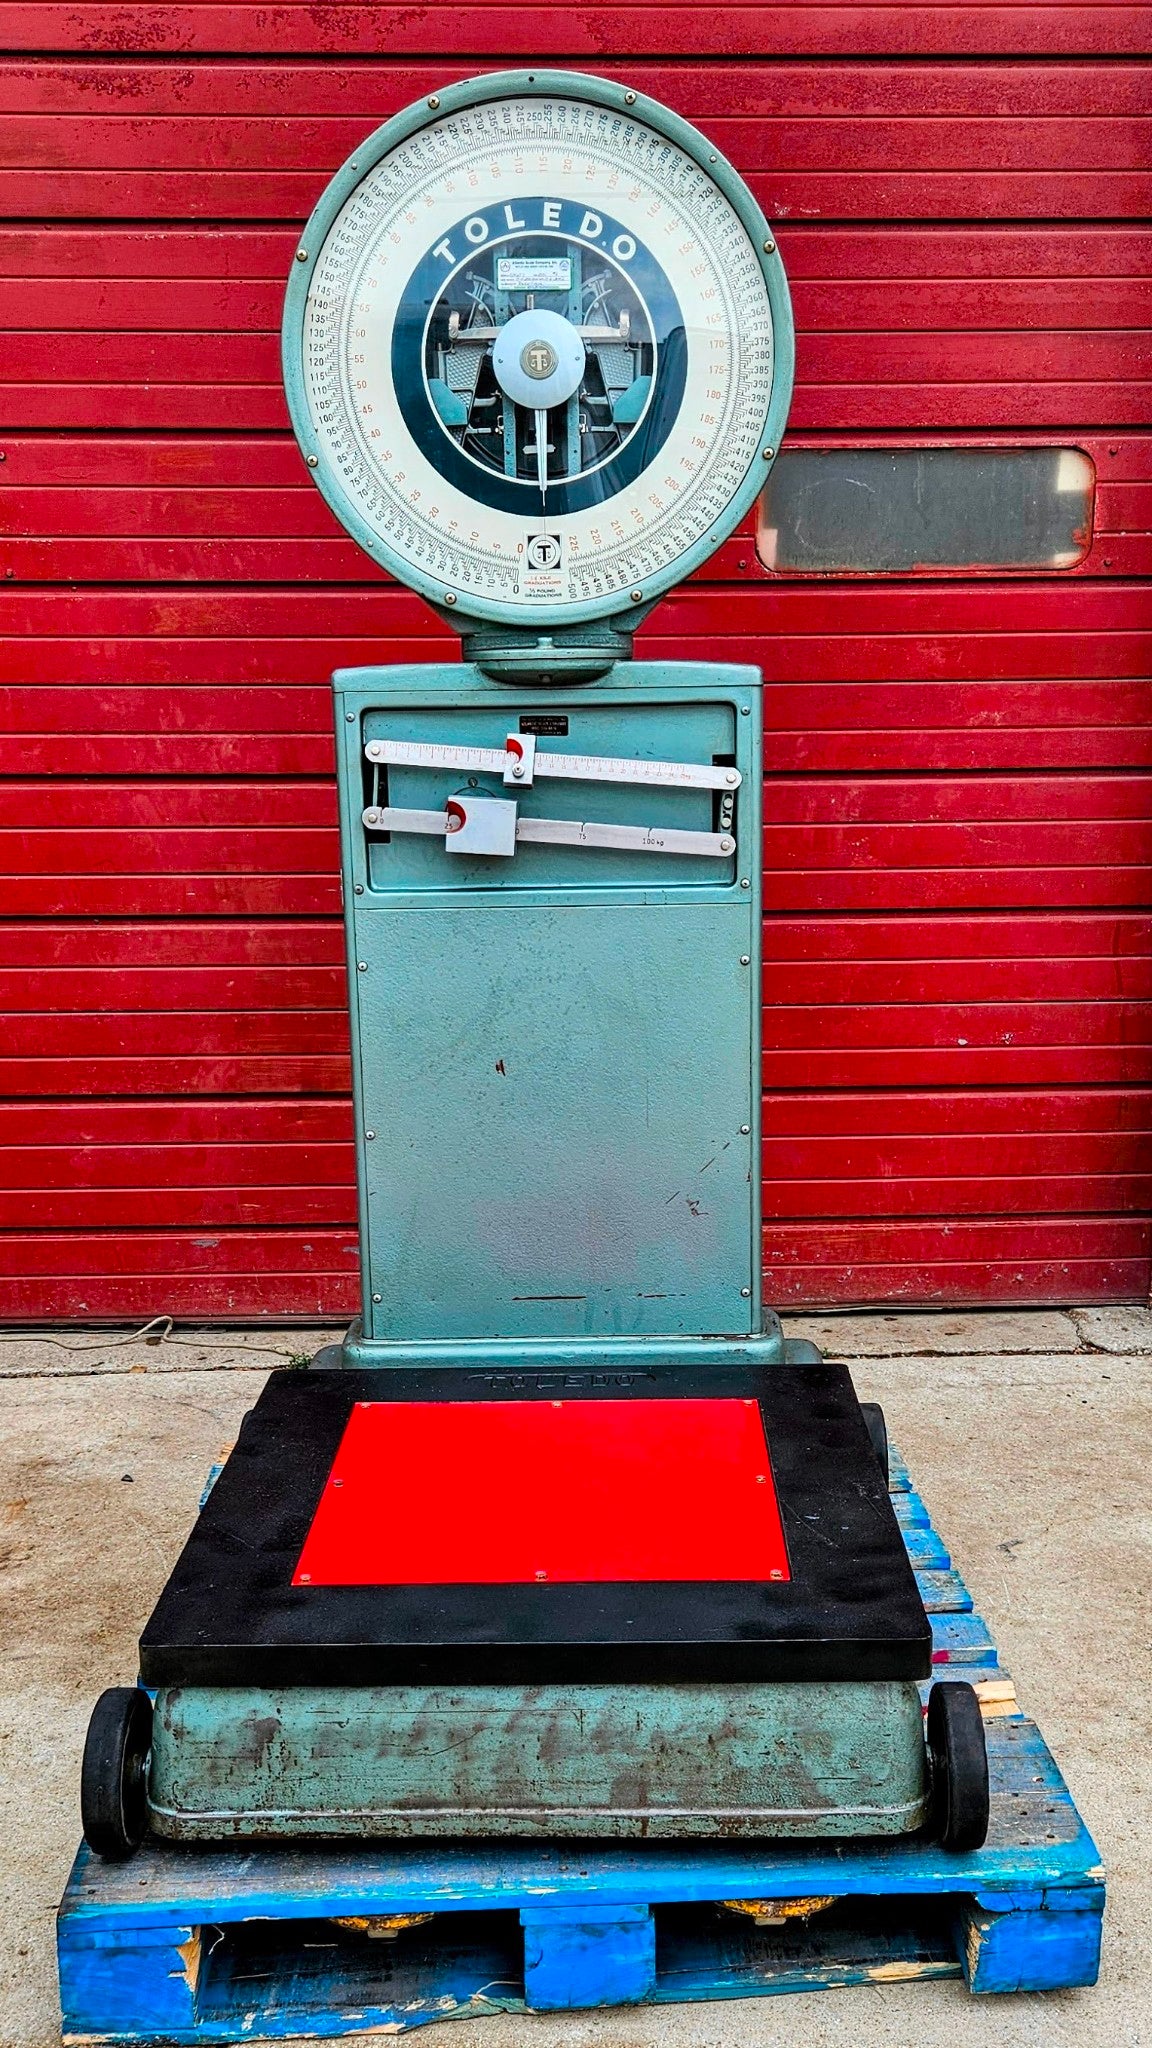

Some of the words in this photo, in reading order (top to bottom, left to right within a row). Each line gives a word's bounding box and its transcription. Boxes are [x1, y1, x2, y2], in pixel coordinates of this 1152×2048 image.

[487, 109, 498, 127] 235
[501, 106, 511, 124] 240
[515, 105, 525, 123] 245
[527, 112, 542, 122] 250
[544, 104, 553, 122] 255
[557, 105, 567, 123] 260
[570, 106, 581, 125] 265
[583, 110, 595, 129] 270
[460, 117, 473, 135] 225
[474, 112, 484, 130] 230
[597, 113, 608, 132] 275
[447, 122, 459, 140] 220
[610, 119, 622, 137] 280
[624, 124, 635, 144] 285
[421, 135, 435, 153] 210
[433, 128, 448, 147] 215
[635, 131, 648, 149] 290
[410, 143, 425, 160] 205
[646, 138, 660, 158] 295
[398, 151, 413, 168] 200
[657, 146, 672, 165] 300
[387, 161, 402, 177] 195
[489, 161, 501, 179] 105
[515, 157, 524, 174] 110
[538, 156, 548, 173] 115
[562, 158, 572, 175] 120
[669, 154, 683, 173] 305
[377, 171, 392, 186] 190
[585, 164, 596, 182] 125
[680, 164, 694, 182] 310
[607, 173, 619, 191] 130
[690, 174, 704, 192] 315
[368, 181, 383, 198] 185
[698, 185, 714, 202] 320
[358, 192, 373, 208] 180
[706, 196, 723, 213] 325
[350, 204, 364, 219] 175
[714, 210, 731, 225] 330
[343, 217, 358, 231] 170
[722, 222, 739, 237] 335
[336, 230, 351, 243] 165
[432, 202, 636, 264] TOLEDO
[330, 242, 345, 255] 160
[728, 235, 745, 250] 340
[325, 256, 339, 268] 155
[735, 248, 751, 263] 345
[741, 262, 756, 276] 350
[320, 270, 335, 282] 150
[745, 276, 760, 290] 355
[316, 284, 331, 296] 145
[700, 288, 715, 301] 160
[748, 292, 764, 303] 360
[313, 299, 328, 310] 140
[751, 306, 767, 317] 365
[311, 313, 326, 324] 135
[705, 313, 721, 325] 165
[752, 320, 769, 331] 370
[309, 328, 325, 338] 130
[355, 329, 366, 337] 60
[309, 343, 324, 352] 125
[709, 340, 724, 349] 170
[754, 337, 770, 346] 375
[309, 357, 324, 366] 120
[354, 355, 365, 363] 55
[755, 351, 770, 359] 380
[709, 365, 724, 374] 175
[754, 366, 769, 375] 385
[310, 372, 325, 381] 115
[312, 386, 327, 396] 110
[356, 380, 367, 389] 50
[752, 381, 768, 389] 390
[706, 389, 721, 399] 180
[751, 394, 766, 404] 395
[315, 400, 330, 410] 105
[362, 404, 373, 414] 45
[319, 413, 334, 425] 100
[700, 413, 715, 424] 185
[748, 407, 764, 418] 400
[326, 426, 337, 436] 95
[370, 428, 381, 438] 40
[745, 421, 760, 432] 405
[331, 440, 342, 450] 90
[691, 436, 706, 448] 190
[740, 435, 756, 446] 410
[337, 452, 348, 464] 85
[381, 450, 393, 461] 35
[735, 448, 751, 460] 415
[343, 465, 354, 476] 80
[680, 457, 694, 471] 195
[730, 460, 745, 473] 420
[350, 476, 360, 488] 75
[395, 471, 406, 483] 30
[664, 476, 680, 491] 200
[723, 472, 738, 485] 425
[357, 489, 368, 499] 70
[411, 489, 421, 501] 25
[716, 484, 731, 498] 430
[366, 499, 377, 511] 65
[648, 493, 663, 508] 205
[709, 496, 724, 509] 435
[375, 510, 386, 522] 60
[429, 506, 440, 518] 20
[630, 508, 644, 524] 210
[701, 506, 715, 520] 440
[384, 519, 395, 531] 55
[448, 520, 458, 531] 15
[610, 520, 624, 536] 215
[692, 517, 707, 531] 445
[393, 529, 405, 541] 50
[469, 531, 479, 542] 10
[590, 529, 601, 545] 220
[682, 527, 697, 541] 450
[404, 537, 415, 549] 45
[517, 543, 524, 553] 0
[568, 536, 580, 552] 225
[673, 535, 687, 550] 455
[415, 546, 425, 558] 40
[537, 545, 551, 562] T
[662, 543, 676, 559] 460
[426, 552, 436, 565] 35
[641, 557, 653, 573] 470
[651, 551, 664, 566] 465
[437, 560, 447, 572] 30
[449, 564, 459, 577] 25
[629, 563, 641, 579] 475
[462, 571, 471, 582] 20
[474, 576, 483, 585] 15
[605, 574, 616, 590] 485
[617, 569, 629, 585] 480
[487, 579, 496, 588] 10
[513, 584, 520, 594] 0
[581, 580, 591, 597] 495
[593, 577, 603, 593] 490
[568, 584, 577, 599] 500
[444, 822, 453, 830] 25
[578, 832, 587, 840] 75
[484, 1375, 635, 1389] TOLEDO
